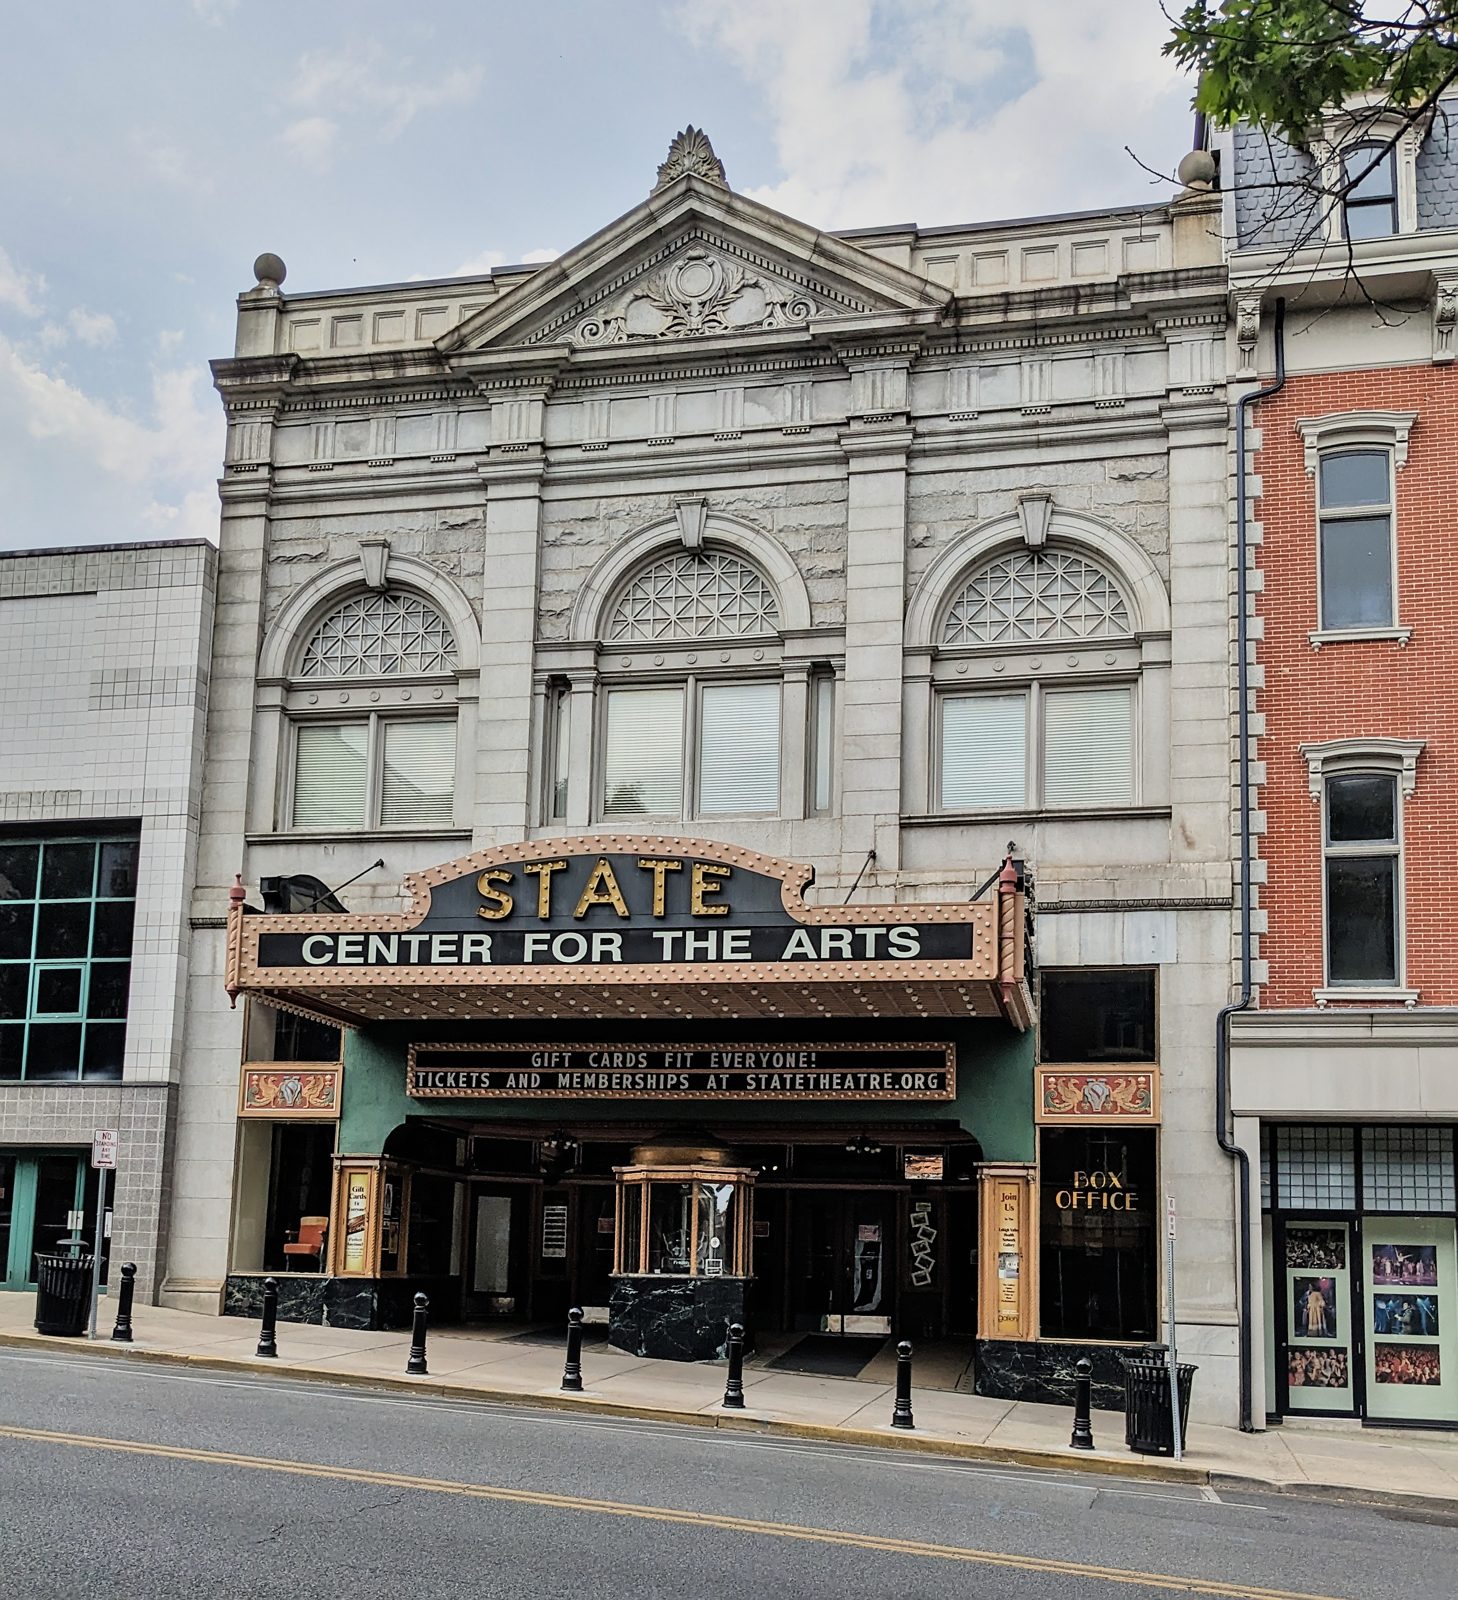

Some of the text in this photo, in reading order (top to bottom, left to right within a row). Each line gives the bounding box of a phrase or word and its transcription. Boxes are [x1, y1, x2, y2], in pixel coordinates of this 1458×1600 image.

[477, 856, 731, 920] STATE
[301, 926, 921, 965] CENTER FOR THE ARTS
[531, 1052, 817, 1068] GIFT CARDS FIT EVERYONE!
[416, 1072, 939, 1090] TICKETS AND MEMBERSHIPS AT STATETHEATRE.ORG
[102, 1132, 112, 1140] NO
[1073, 1171, 1123, 1189] BOX
[1001, 1193, 1017, 1202] Join
[1055, 1190, 1139, 1211] OFFICE
[1004, 1203, 1015, 1212] Us
